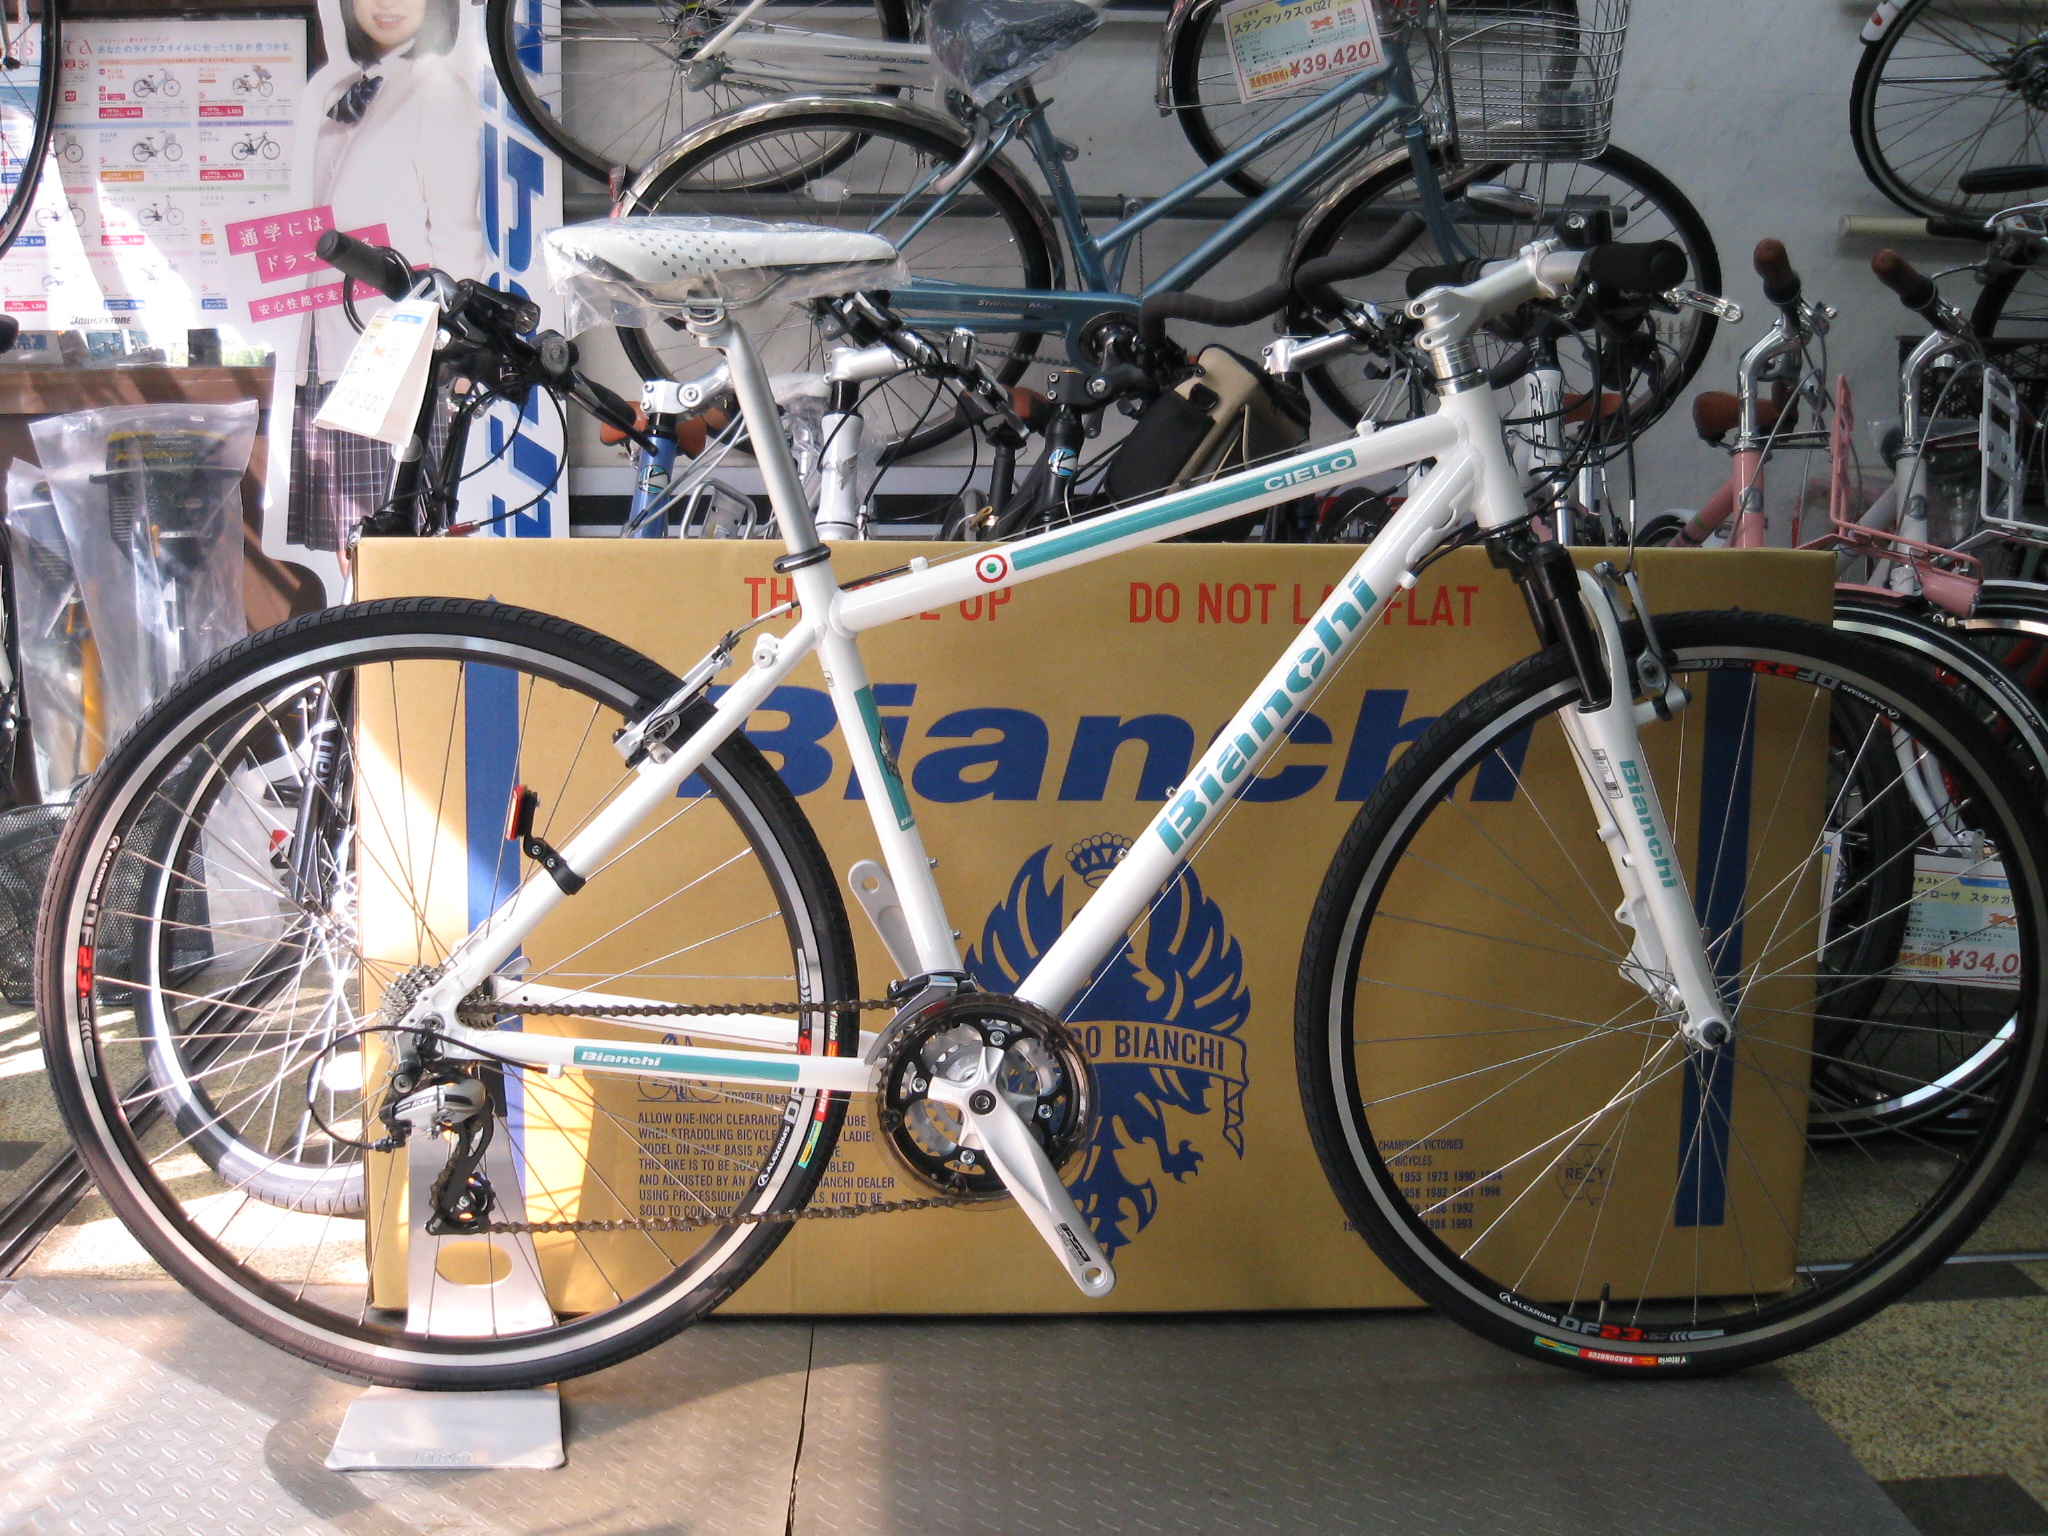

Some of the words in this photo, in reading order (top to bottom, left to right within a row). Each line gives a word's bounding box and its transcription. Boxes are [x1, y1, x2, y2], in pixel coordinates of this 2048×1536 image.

[1289, 41, 1371, 78] ¥39,420
[239, 216, 324, 248] 通学には
[258, 286, 377, 316] 安心性能で走う。
[1264, 454, 1354, 492] CIELO
[1130, 583, 1180, 624] DO
[1198, 583, 1276, 625] NOT
[1752, 660, 1842, 690] DF23
[1155, 573, 1378, 856] Bianchi
[676, 683, 1538, 803] Bianchi
[1619, 760, 1678, 888] Bianchi
[77, 902, 99, 992] DF23
[1946, 949, 2020, 974] ¥34,0
[1115, 1025, 1225, 1071] BIANCHI
[581, 1051, 662, 1067] Bianchi
[725, 1092, 762, 1103] PROPER
[639, 1113, 672, 1123] ALLOW
[676, 1113, 723, 1124] ONE-INCH
[639, 1128, 668, 1139] WHEN
[672, 1128, 733, 1140] STRADDLING
[639, 1144, 675, 1154] MODEL
[676, 1144, 690, 1154] ON
[693, 1145, 722, 1156] SAME
[725, 1145, 753, 1156] BASIS
[757, 1145, 769, 1156] AS
[766, 1125, 790, 1173] ALEXRIMS
[1379, 1140, 1420, 1150] CHAMPION
[1424, 1139, 1464, 1149] VICTORIES
[639, 1159, 661, 1170] THIS
[665, 1159, 685, 1170] BIKE
[689, 1160, 698, 1170] IS
[703, 1160, 714, 1171] TO
[718, 1160, 729, 1171] BE
[734, 1160, 759, 1172] SOLD
[1395, 1156, 1433, 1166] BICYCLES
[639, 1174, 659, 1186] AND
[662, 1174, 713, 1186] ADJUSTED
[716, 1175, 729, 1186] BY
[732, 1175, 746, 1187] AN
[857, 1177, 895, 1188] DEALER
[1399, 1172, 1421, 1182] 1953
[1426, 1172, 1448, 1182] 1973
[1454, 1171, 1475, 1181] 1990
[639, 1189, 669, 1201] USING
[832, 1192, 852, 1203] NOT
[854, 1192, 867, 1203] TO
[870, 1193, 882, 1203] BE
[1426, 1188, 1447, 1198] 1982
[1480, 1187, 1501, 1197] 1996
[639, 1205, 665, 1216] SOLD
[668, 1205, 680, 1216] TO
[684, 1205, 732, 1217] CONSUME
[1452, 1203, 1474, 1213] 1992
[1451, 1219, 1473, 1229] 1993
[1512, 1300, 1557, 1323] ALEXRIMS
[1558, 1315, 1643, 1342] DF23
[1587, 1351, 1633, 1364] RANDONNEUR
[1658, 1356, 1688, 1364] Vittoria
